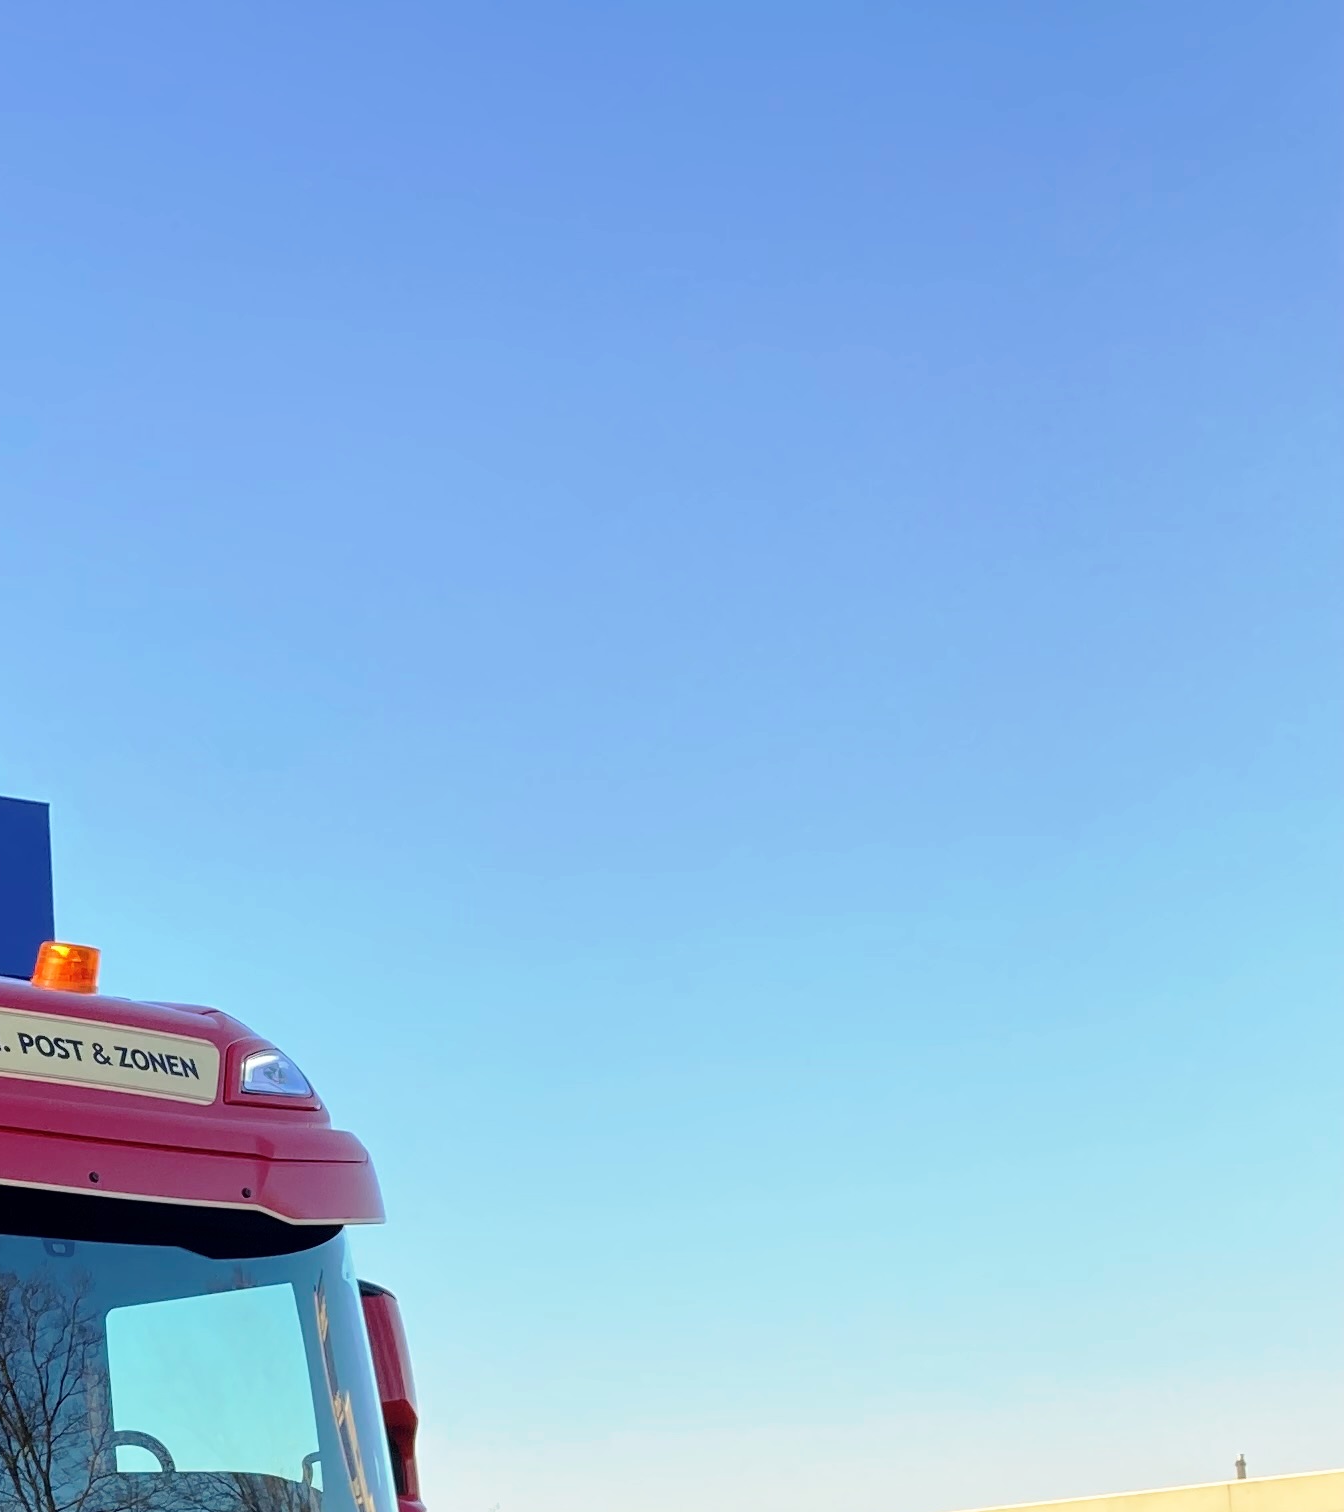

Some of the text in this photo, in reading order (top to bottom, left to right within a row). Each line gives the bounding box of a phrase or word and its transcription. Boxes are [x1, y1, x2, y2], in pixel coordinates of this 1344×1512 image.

[18, 1032, 83, 1063] POST
[92, 1043, 113, 1066] &
[114, 1046, 200, 1081] ZONEN
